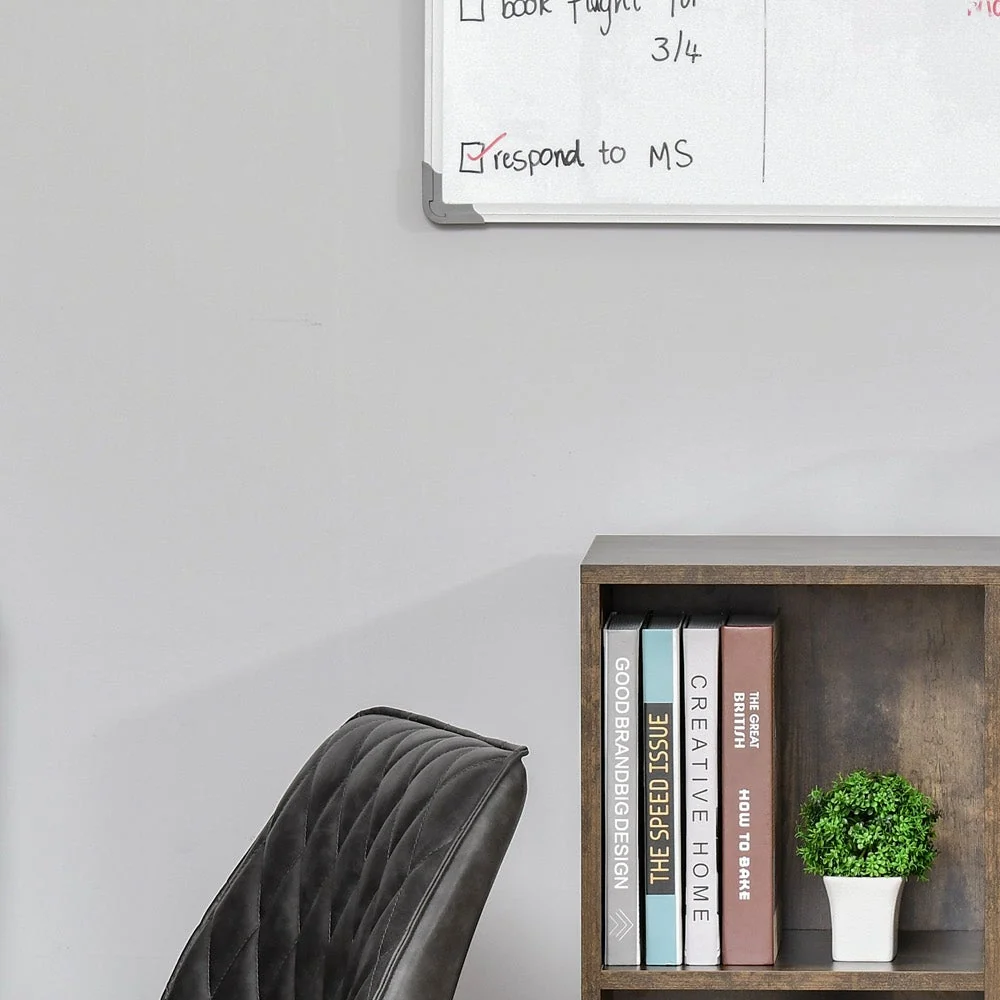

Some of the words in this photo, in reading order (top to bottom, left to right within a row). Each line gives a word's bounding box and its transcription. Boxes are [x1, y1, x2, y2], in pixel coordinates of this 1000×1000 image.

[651, 29, 702, 64] 3/4
[493, 138, 585, 177] respond
[598, 140, 627, 165] to
[649, 138, 694, 171] MS
[733, 692, 746, 749] BRITISH
[749, 691, 760, 711] THE
[648, 713, 669, 773] ISSUE
[690, 674, 708, 823] CREATIVE
[749, 713, 760, 749] GREAT
[649, 780, 670, 841] SPEED
[738, 788, 751, 828] HOW
[738, 832, 751, 852] TO
[649, 846, 670, 885] THE
[692, 842, 710, 922] HOME
[738, 856, 751, 900] BAKE
